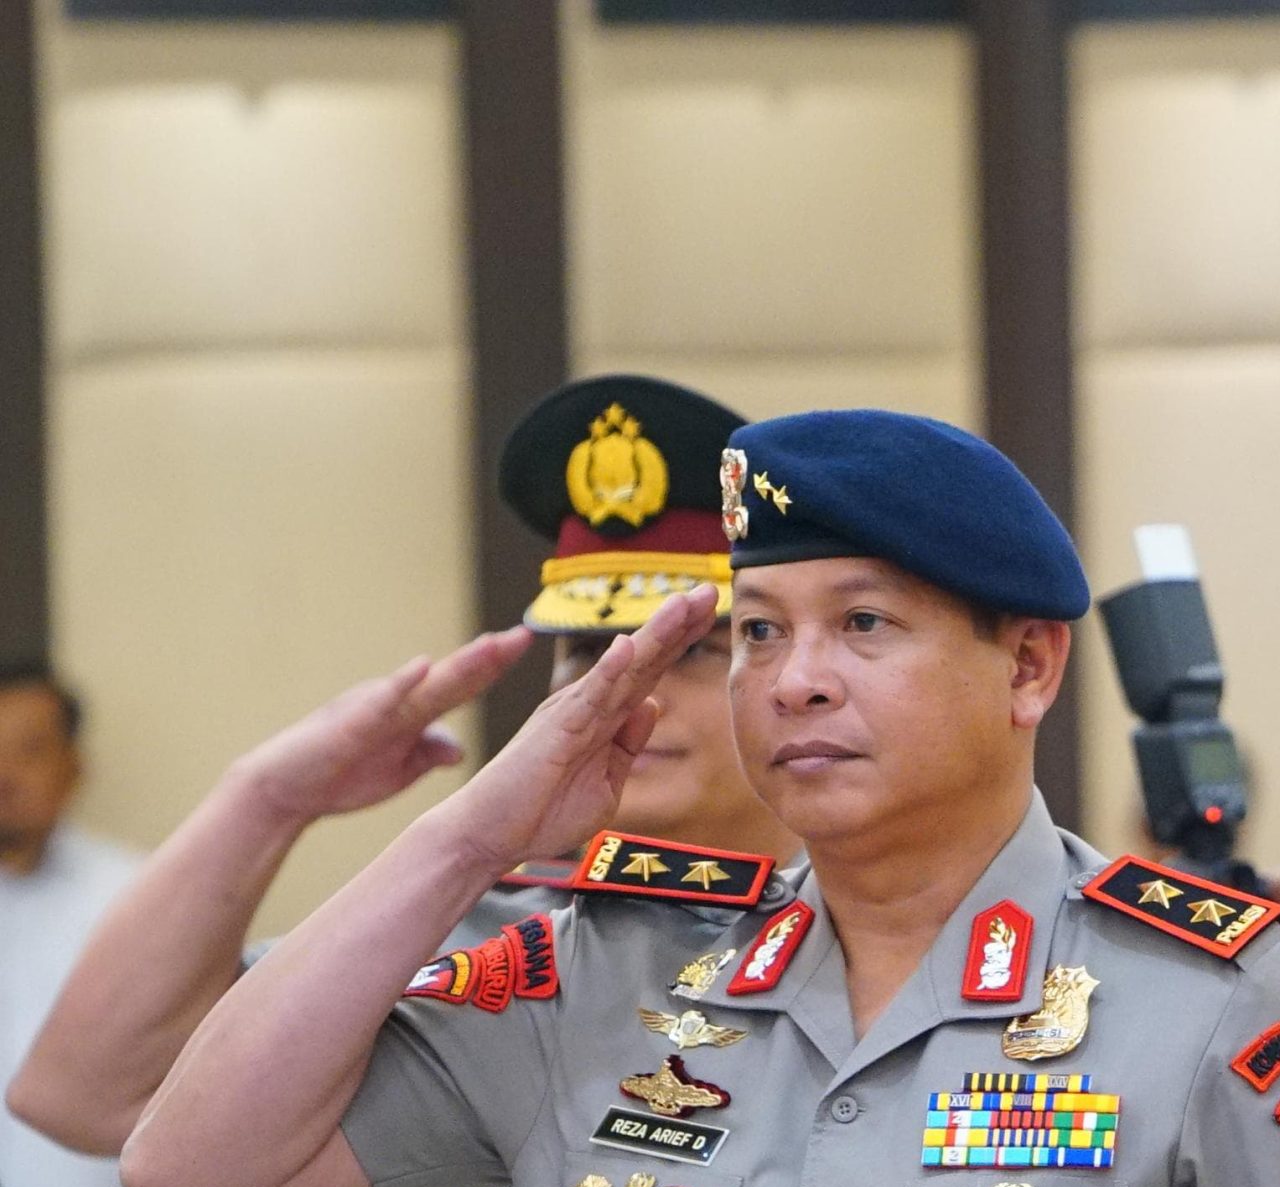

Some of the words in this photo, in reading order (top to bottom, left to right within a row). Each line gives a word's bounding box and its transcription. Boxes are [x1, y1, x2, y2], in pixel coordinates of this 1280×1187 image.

[610, 1118, 648, 1139] REZA
[648, 1126, 692, 1147] ARIEF
[691, 1135, 706, 1151] D
